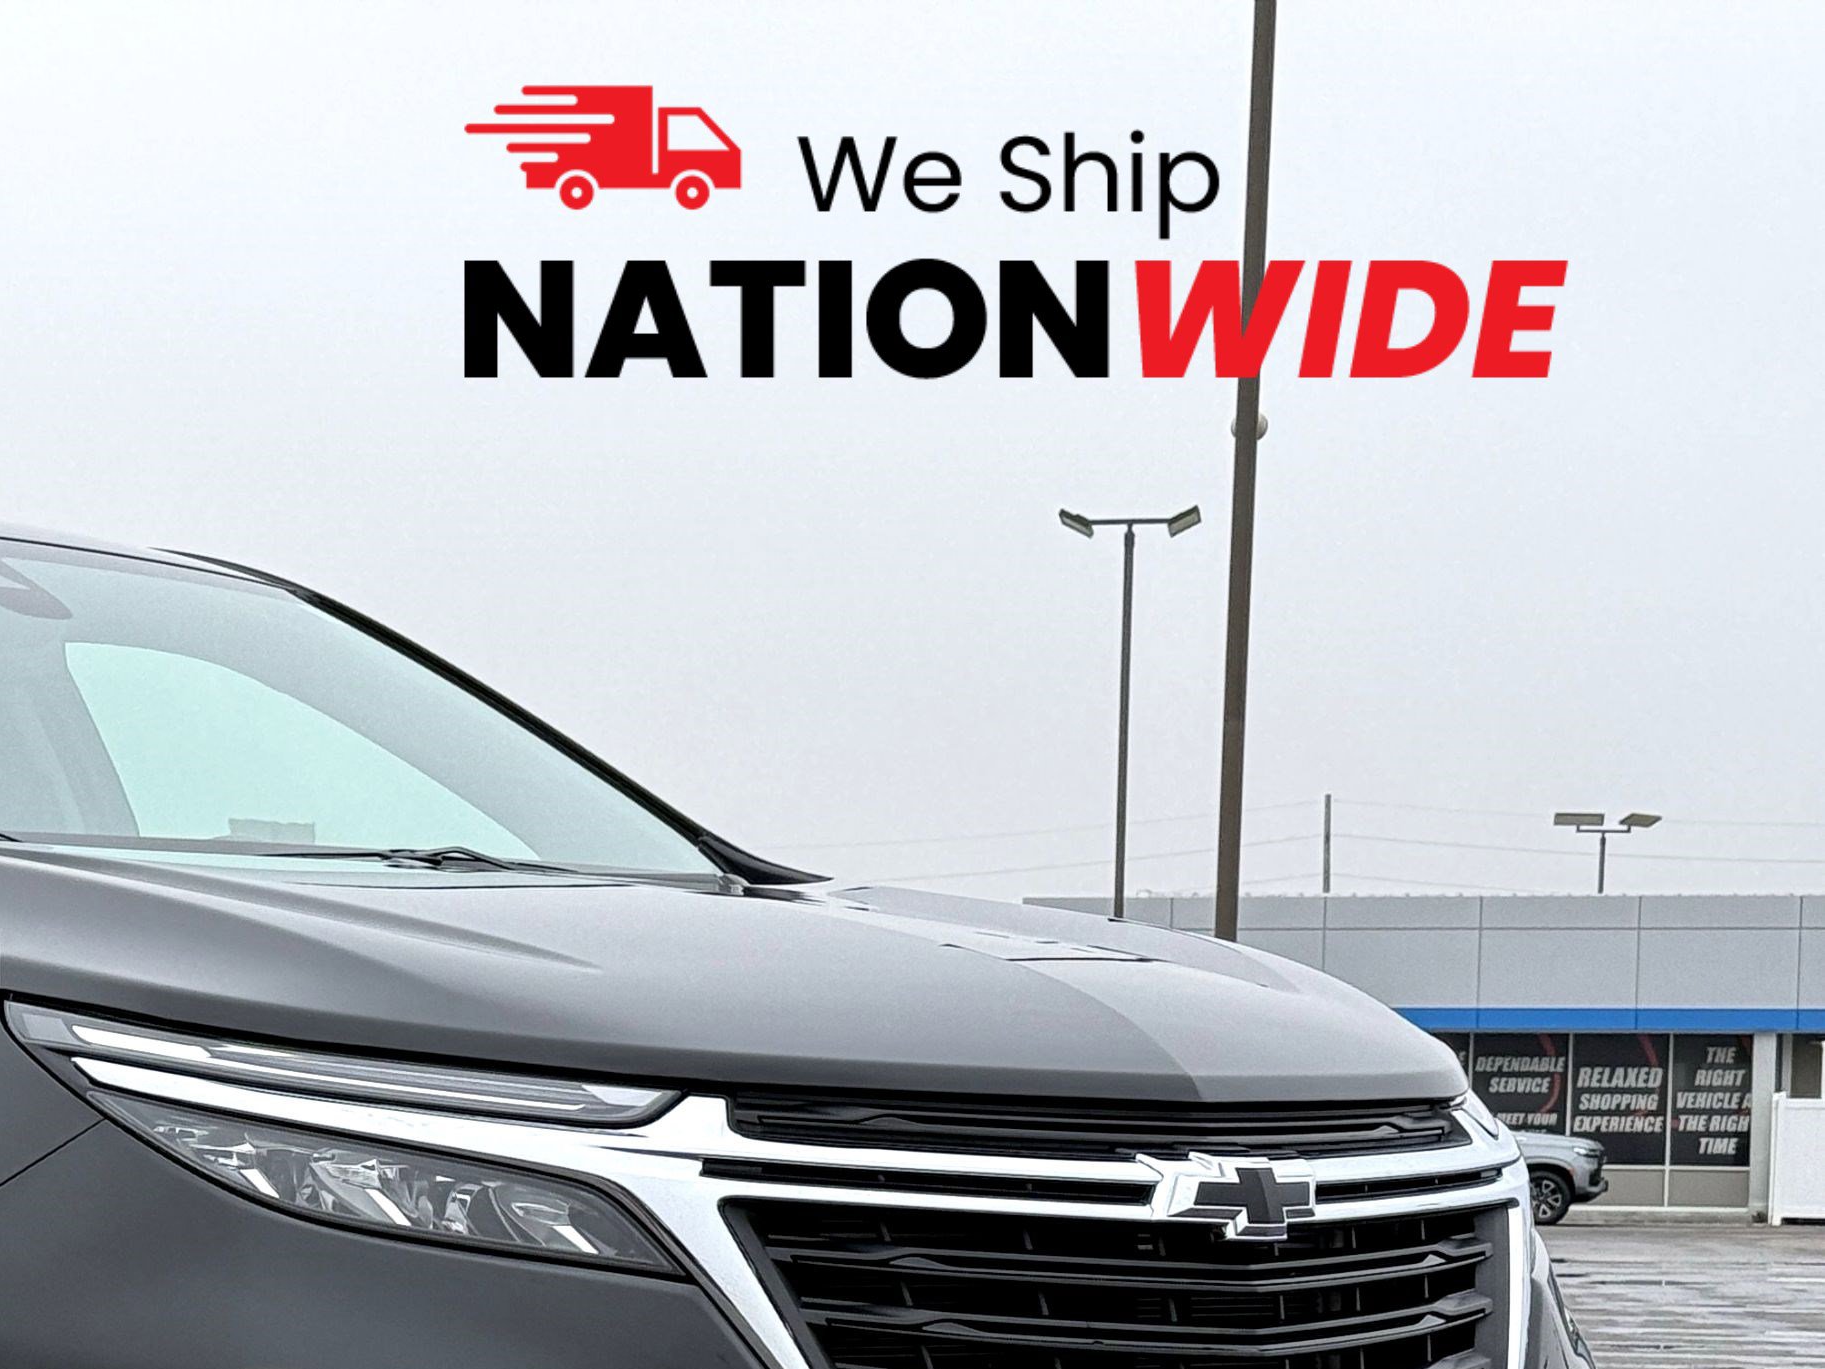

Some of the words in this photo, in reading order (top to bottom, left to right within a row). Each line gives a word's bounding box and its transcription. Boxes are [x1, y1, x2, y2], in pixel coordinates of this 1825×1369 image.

[1475, 1055, 1566, 1073] DEPENDABLE
[1706, 1046, 1736, 1064] THE
[1488, 1076, 1551, 1093] SERVICE
[1576, 1066, 1664, 1089] RELAXED
[1694, 1068, 1746, 1087] RIGHT
[1578, 1093, 1659, 1111] SHOPPING
[1676, 1091, 1742, 1110] VEHICLE
[1527, 1112, 1558, 1126] YOUR
[1572, 1115, 1665, 1133] EXPERIENCE
[1678, 1114, 1709, 1132] THE
[1710, 1114, 1751, 1132] RIGH
[1698, 1137, 1739, 1155] TIME
